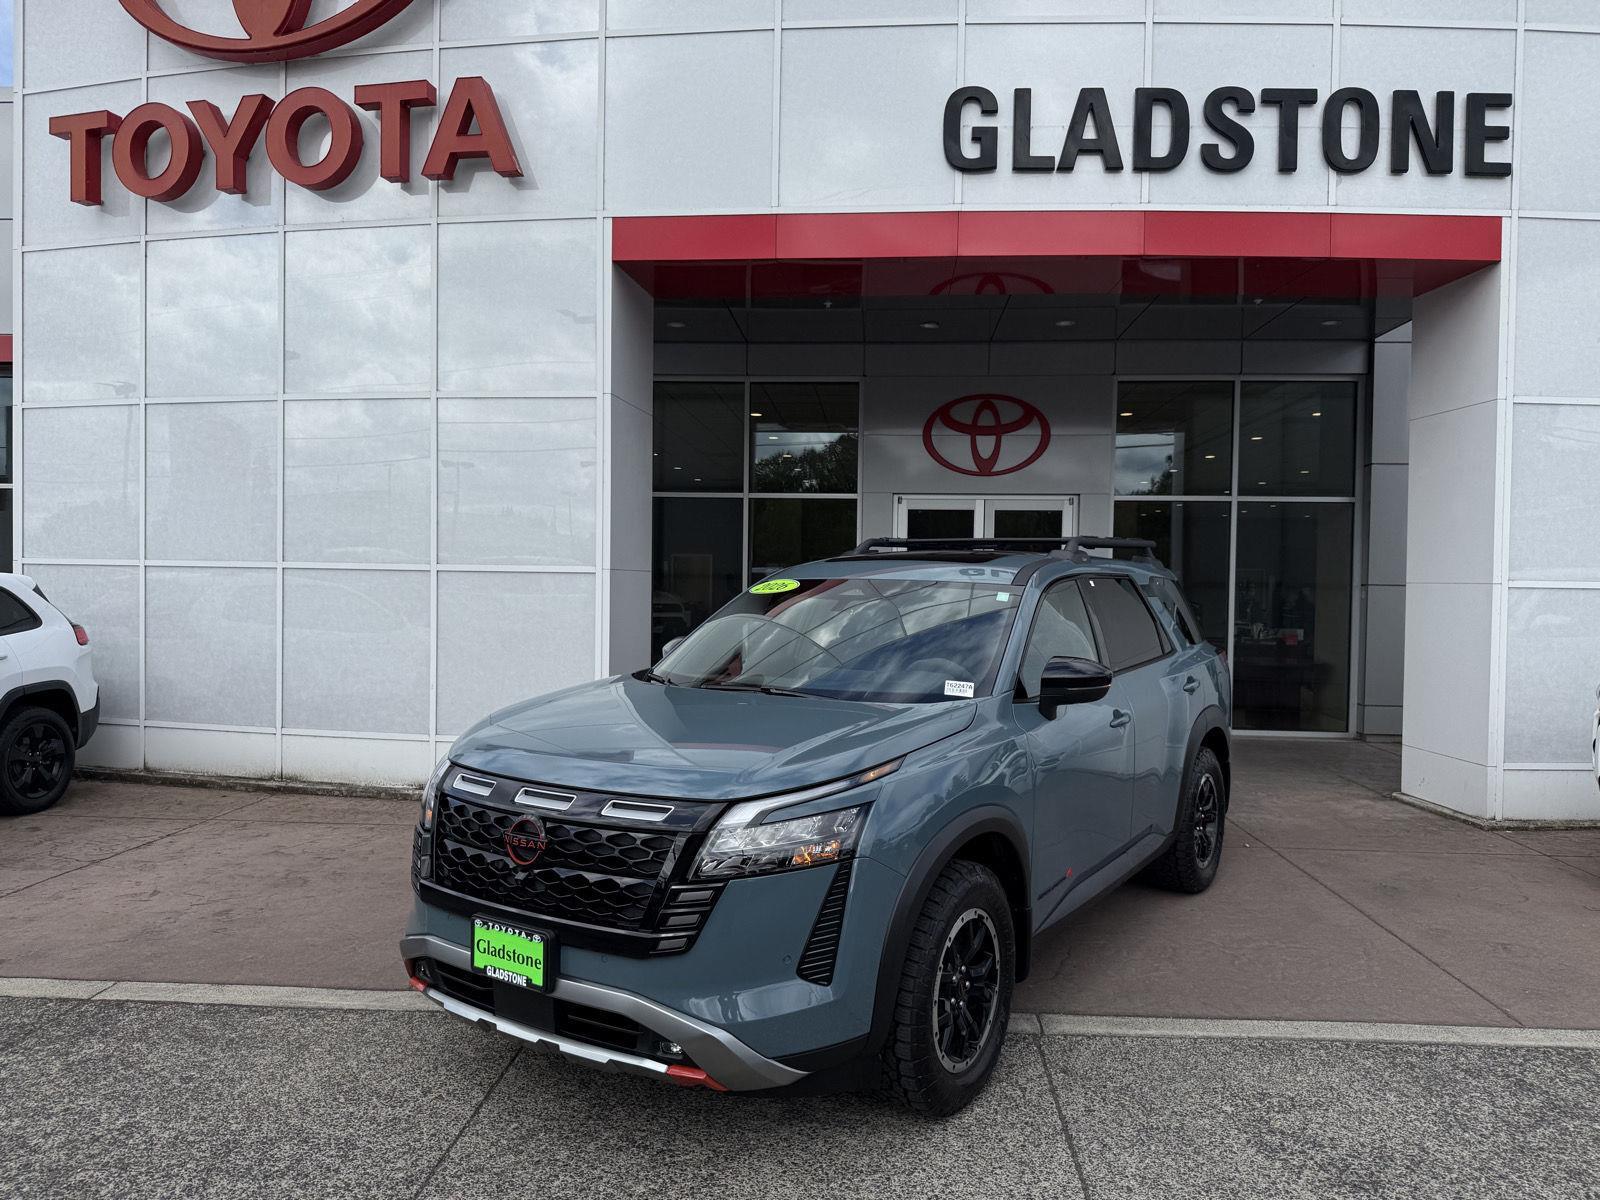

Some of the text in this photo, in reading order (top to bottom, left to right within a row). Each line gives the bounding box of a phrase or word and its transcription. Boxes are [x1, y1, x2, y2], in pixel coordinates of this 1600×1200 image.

[49, 76, 524, 206] TOYOTA
[943, 86, 1513, 177] GLADSTONE
[504, 834, 546, 850] NISSAN
[487, 921, 528, 940] TOYOTA
[476, 938, 542, 970] Gladstone
[486, 965, 528, 987] GLADSTONE
